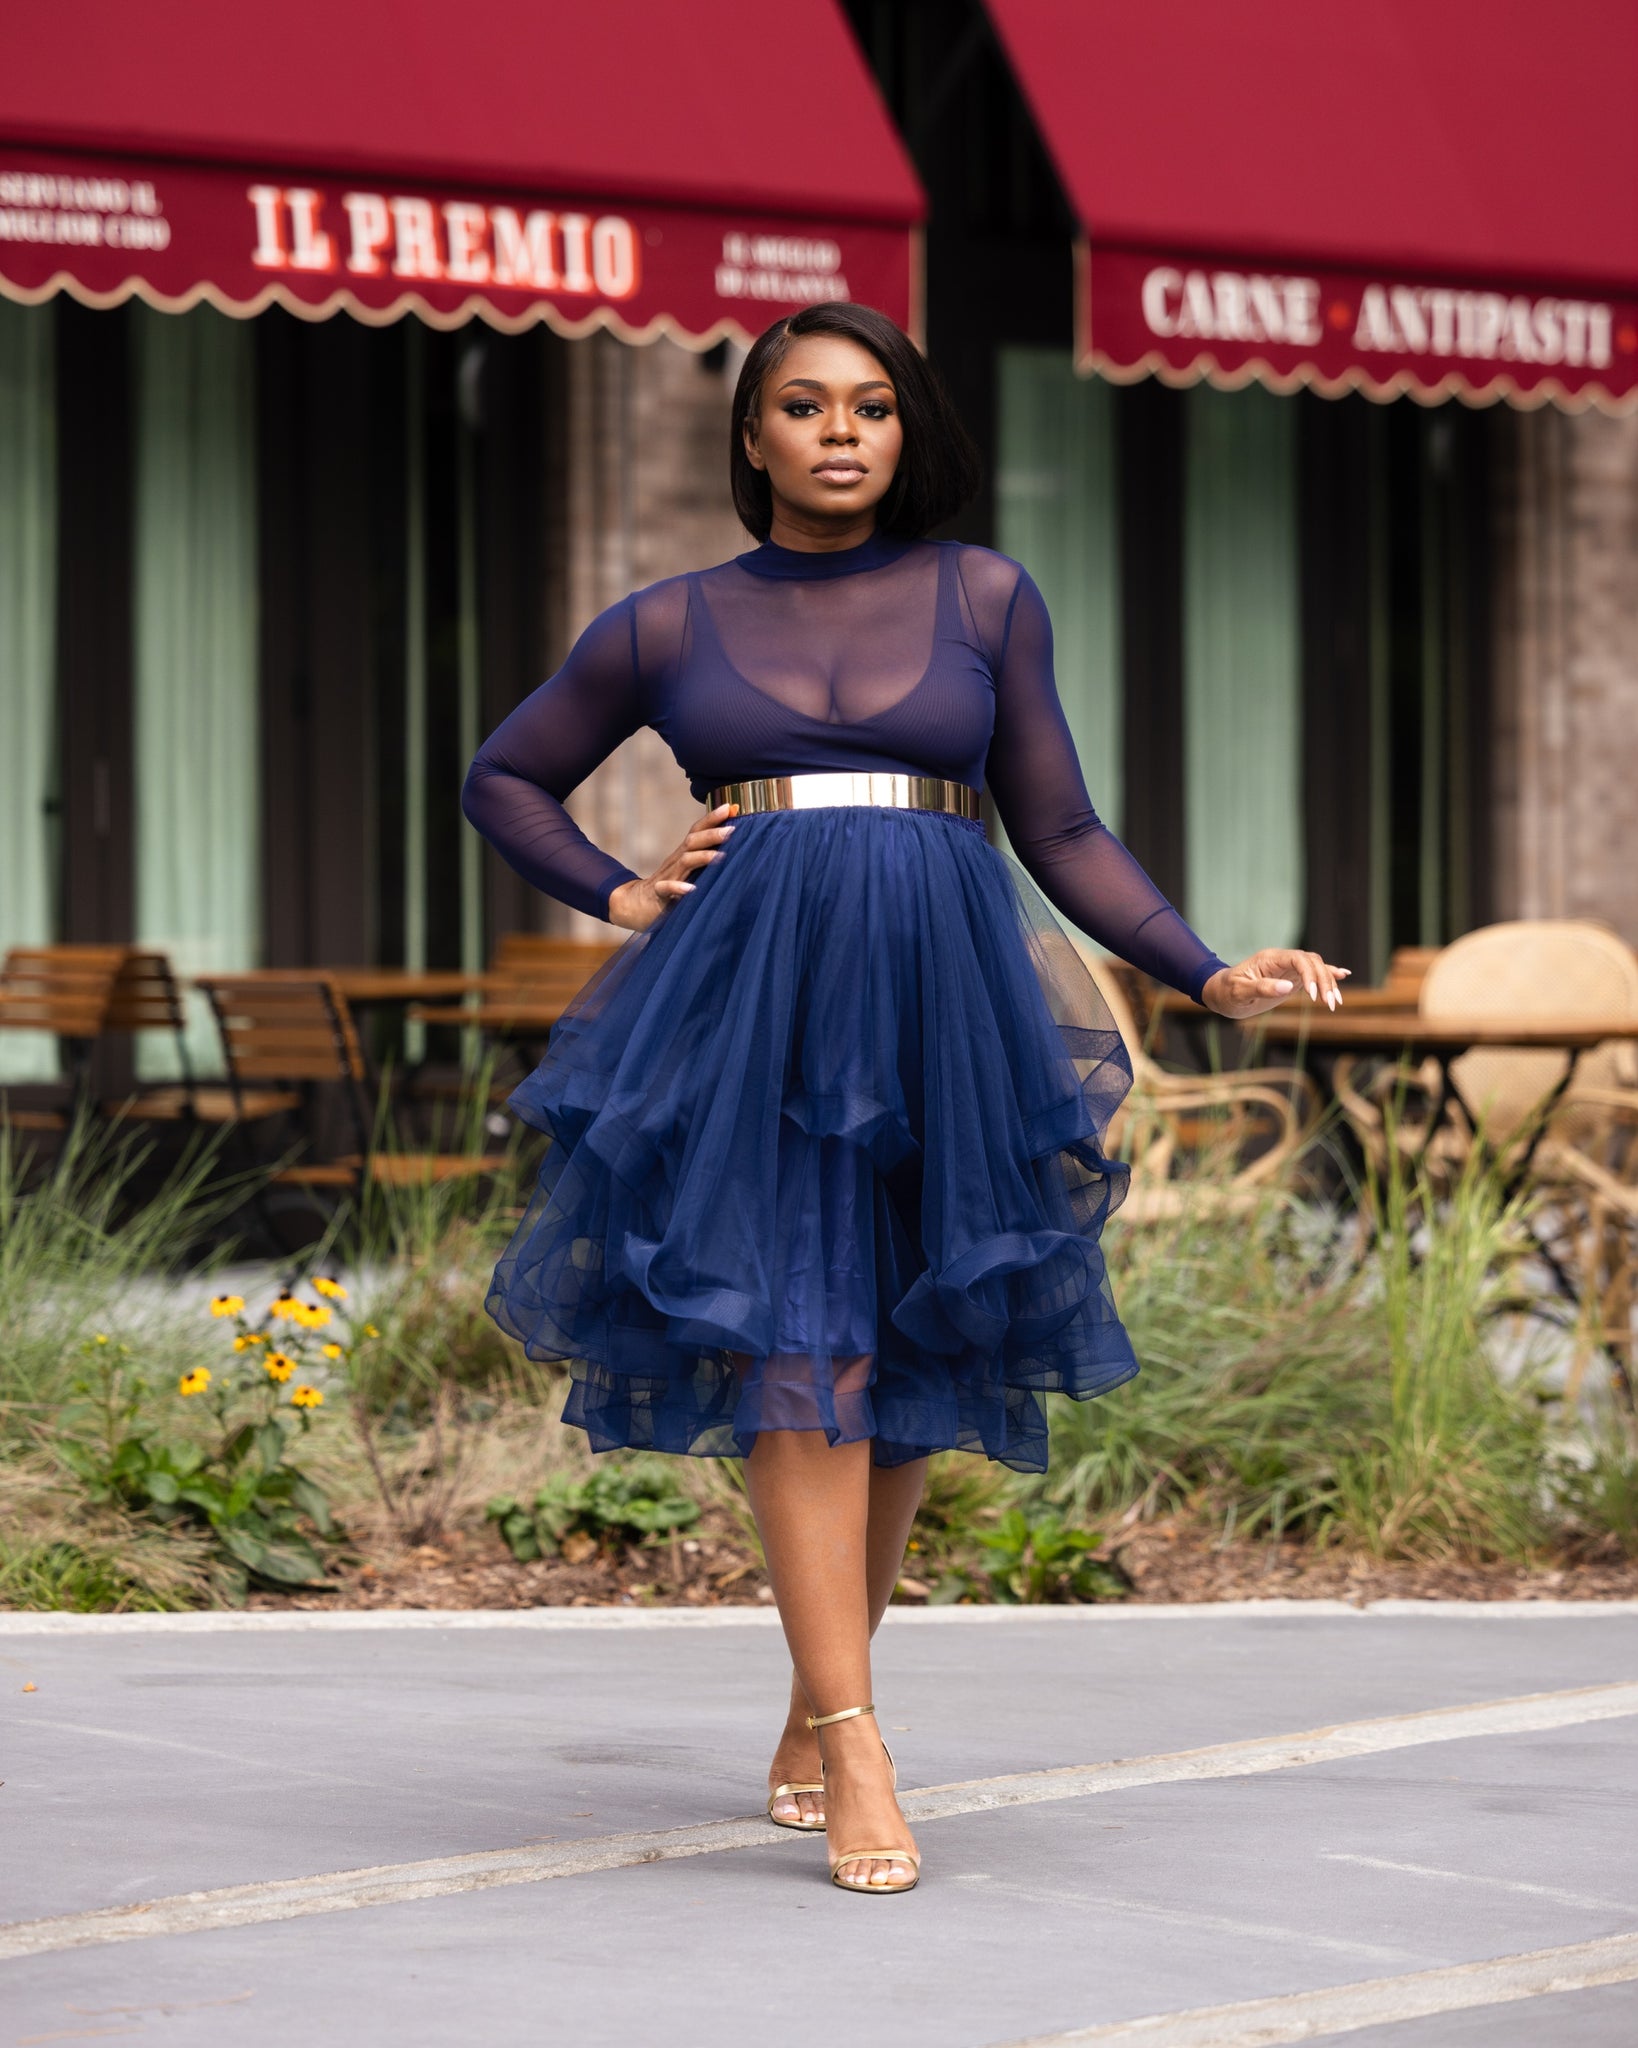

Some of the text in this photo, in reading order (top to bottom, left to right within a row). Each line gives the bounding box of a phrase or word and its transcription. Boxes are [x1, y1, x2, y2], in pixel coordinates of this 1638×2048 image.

[248, 184, 641, 300] IL PREMIO
[1142, 266, 1612, 370] CARNE ANTIPASTI
